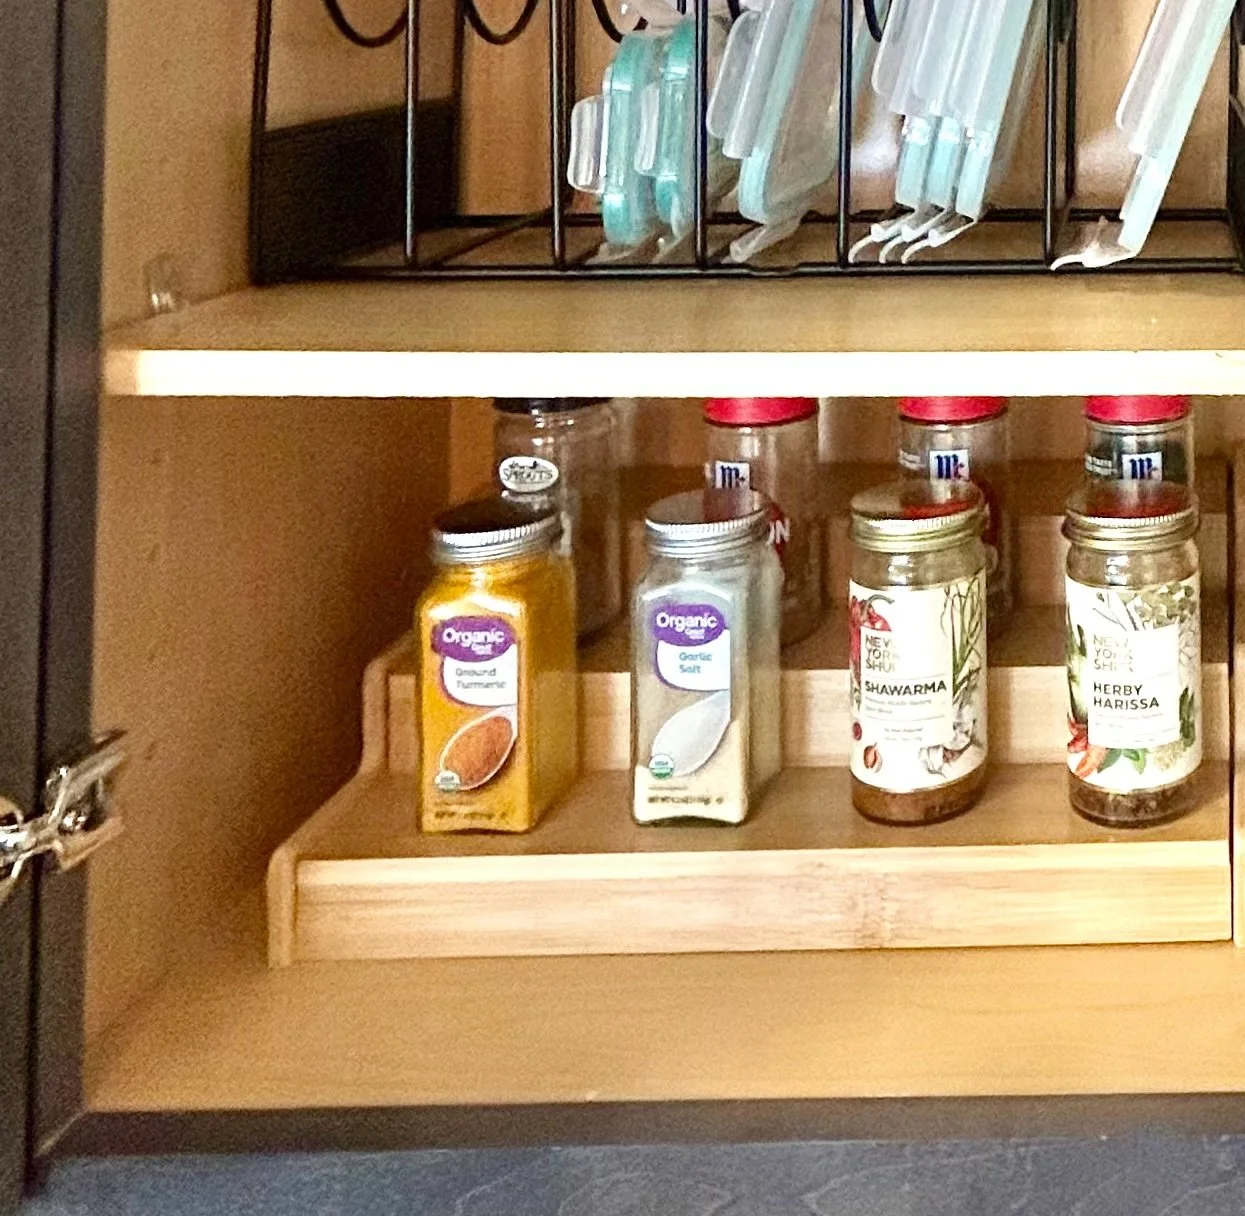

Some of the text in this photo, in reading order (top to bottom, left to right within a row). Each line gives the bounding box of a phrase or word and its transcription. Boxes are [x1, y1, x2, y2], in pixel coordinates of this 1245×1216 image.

[656, 612, 718, 633] Organic
[442, 627, 505, 648] Organic
[679, 651, 712, 661] Garlic
[865, 647, 900, 660] YOR
[455, 667, 497, 677] Ground
[679, 664, 702, 673] Salt
[865, 659, 895, 673] SHU
[456, 680, 506, 689] Turmeric
[864, 680, 947, 696] SHAWARMA
[1093, 681, 1142, 696] HERBY
[1093, 696, 1159, 710] HARISSA
